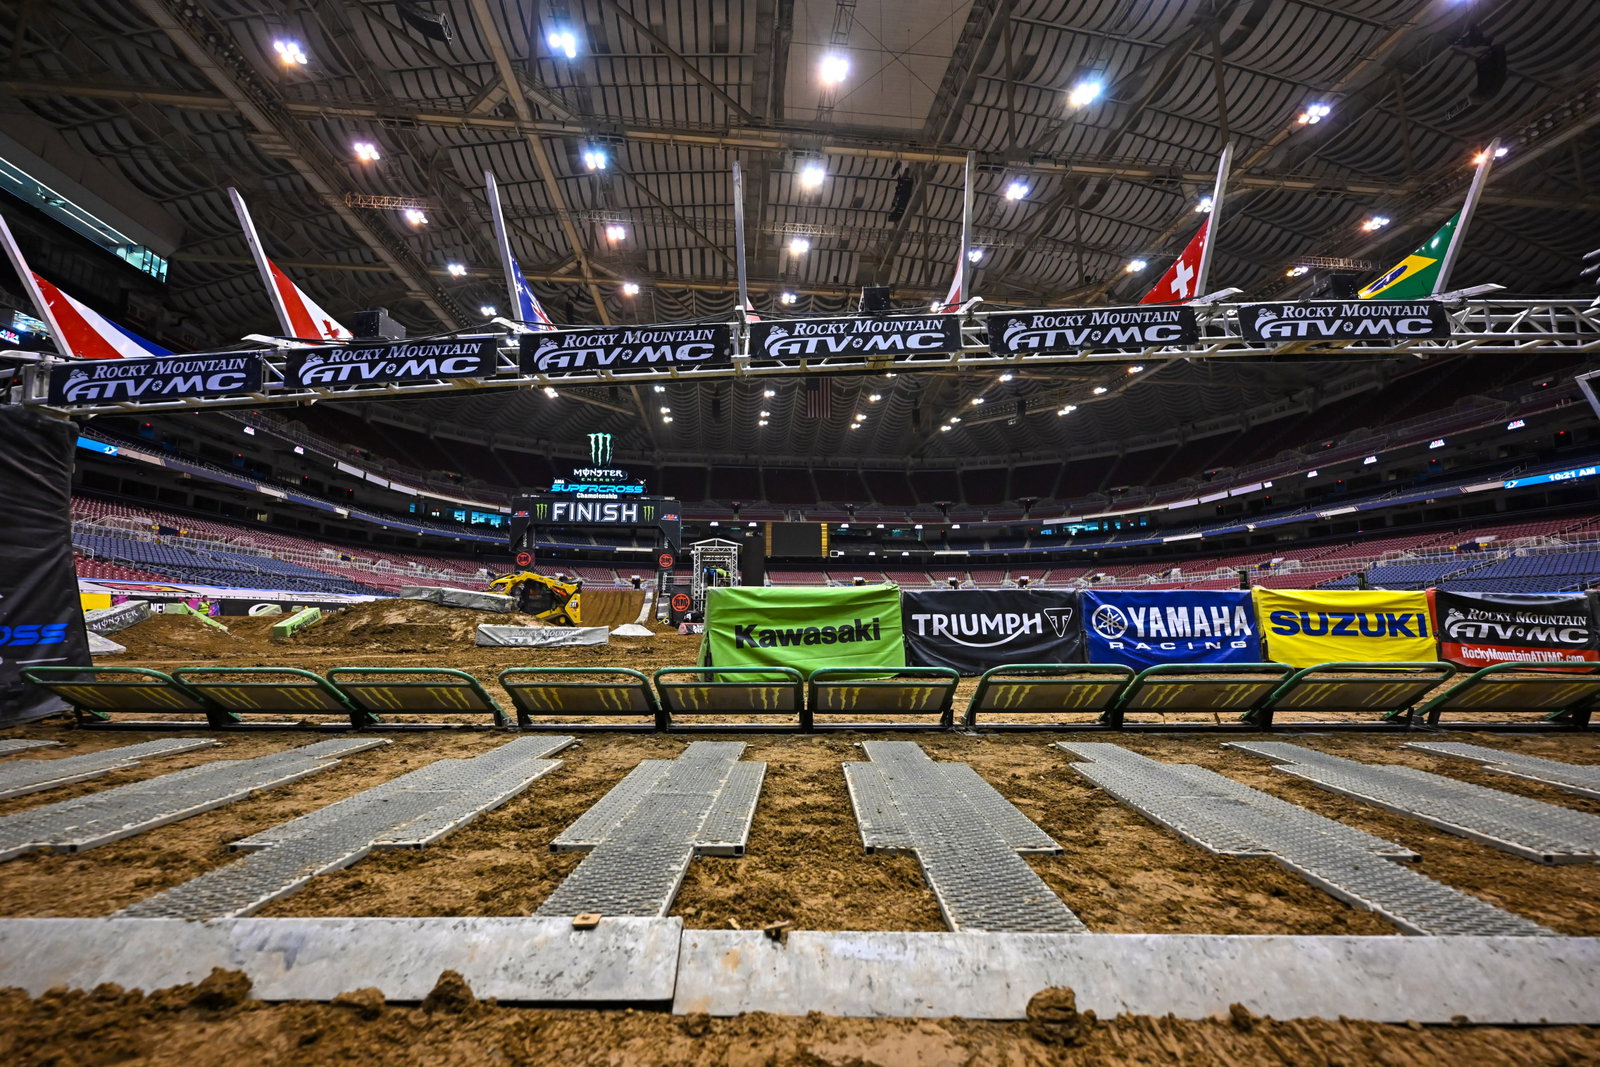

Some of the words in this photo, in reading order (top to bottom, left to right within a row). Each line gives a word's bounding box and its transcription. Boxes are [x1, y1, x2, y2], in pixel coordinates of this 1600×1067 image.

[1030, 315, 1087, 329] ROCKY
[1089, 310, 1181, 326] MOUNTAIN
[1281, 305, 1337, 319] ROCKY
[1340, 303, 1430, 317] MOUNTAIN
[791, 322, 849, 336] ROCKY
[851, 319, 944, 333] MOUNTAIN
[561, 333, 620, 348] ROCKY
[620, 328, 715, 345] MOUNTAIN
[328, 348, 385, 363] ROCKY
[386, 342, 482, 358] MOUNTAIN
[92, 364, 151, 379] ROCKY
[151, 357, 248, 375] MOUNTAIN
[573, 468, 623, 478] MONSTER
[1548, 471, 1576, 481] 10:21
[1579, 467, 1596, 477] AM
[551, 483, 644, 494] SUPERCROSS
[576, 492, 618, 500] Championship
[552, 502, 638, 523] FINISH
[92, 609, 138, 631] MONSTER
[1127, 605, 1252, 638] YAMAHA
[1269, 610, 1428, 638] SUZUKI
[1467, 608, 1512, 623] ROCKY
[1515, 611, 1588, 626] MOUNTAIN
[735, 616, 881, 649] Kawasaki
[912, 612, 1043, 647] TRIUMPH
[1109, 641, 1247, 650] RACING
[1461, 645, 1585, 663] RockyMountainATVMC.com
